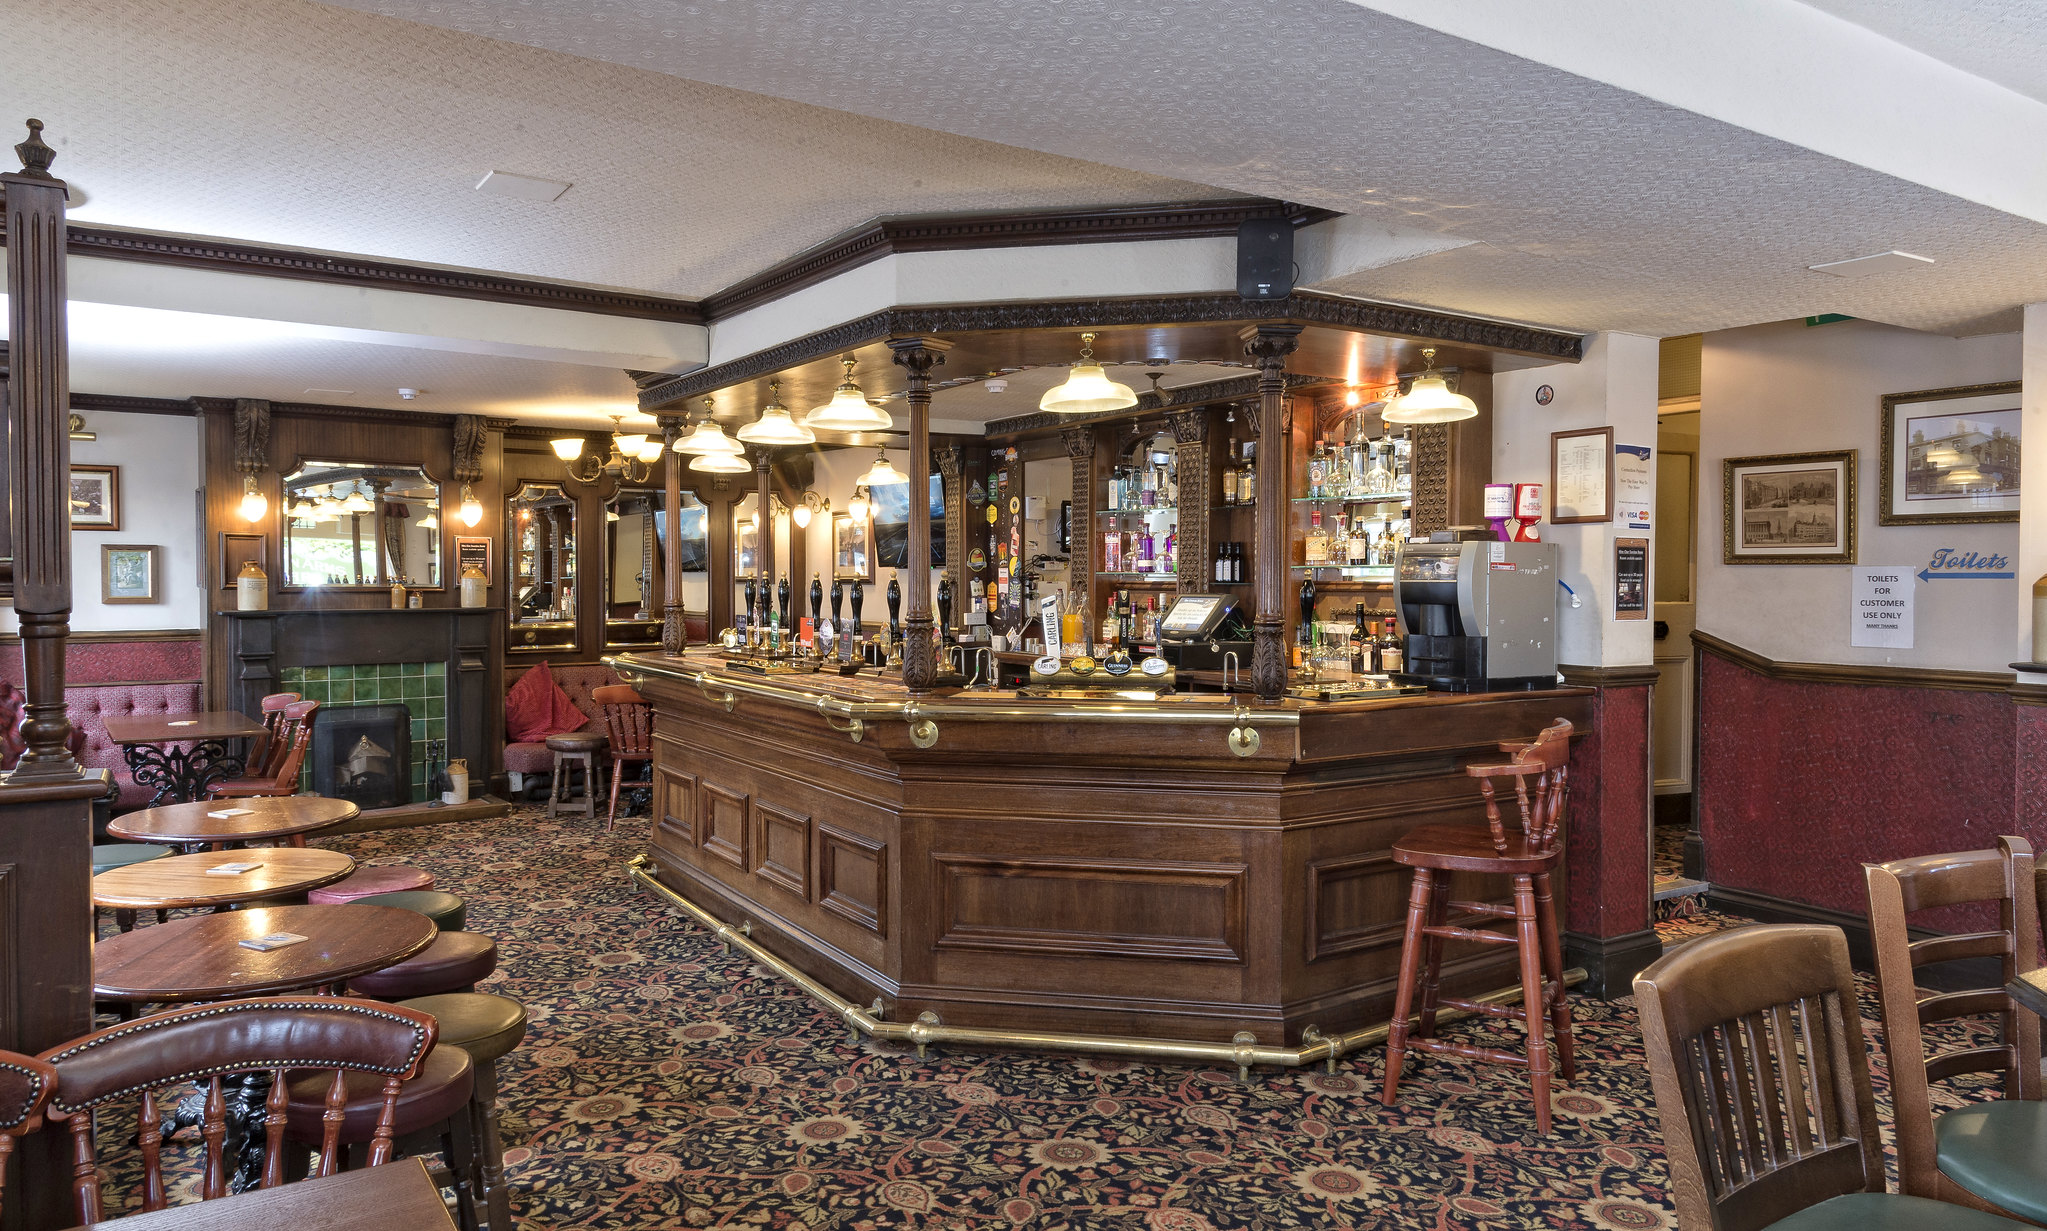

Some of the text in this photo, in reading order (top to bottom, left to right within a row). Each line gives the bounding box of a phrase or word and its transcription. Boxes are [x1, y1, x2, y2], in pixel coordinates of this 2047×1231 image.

[1929, 548, 2008, 570] Toilets
[1874, 587, 1891, 595] FOR
[1045, 612, 1058, 646] CARLING
